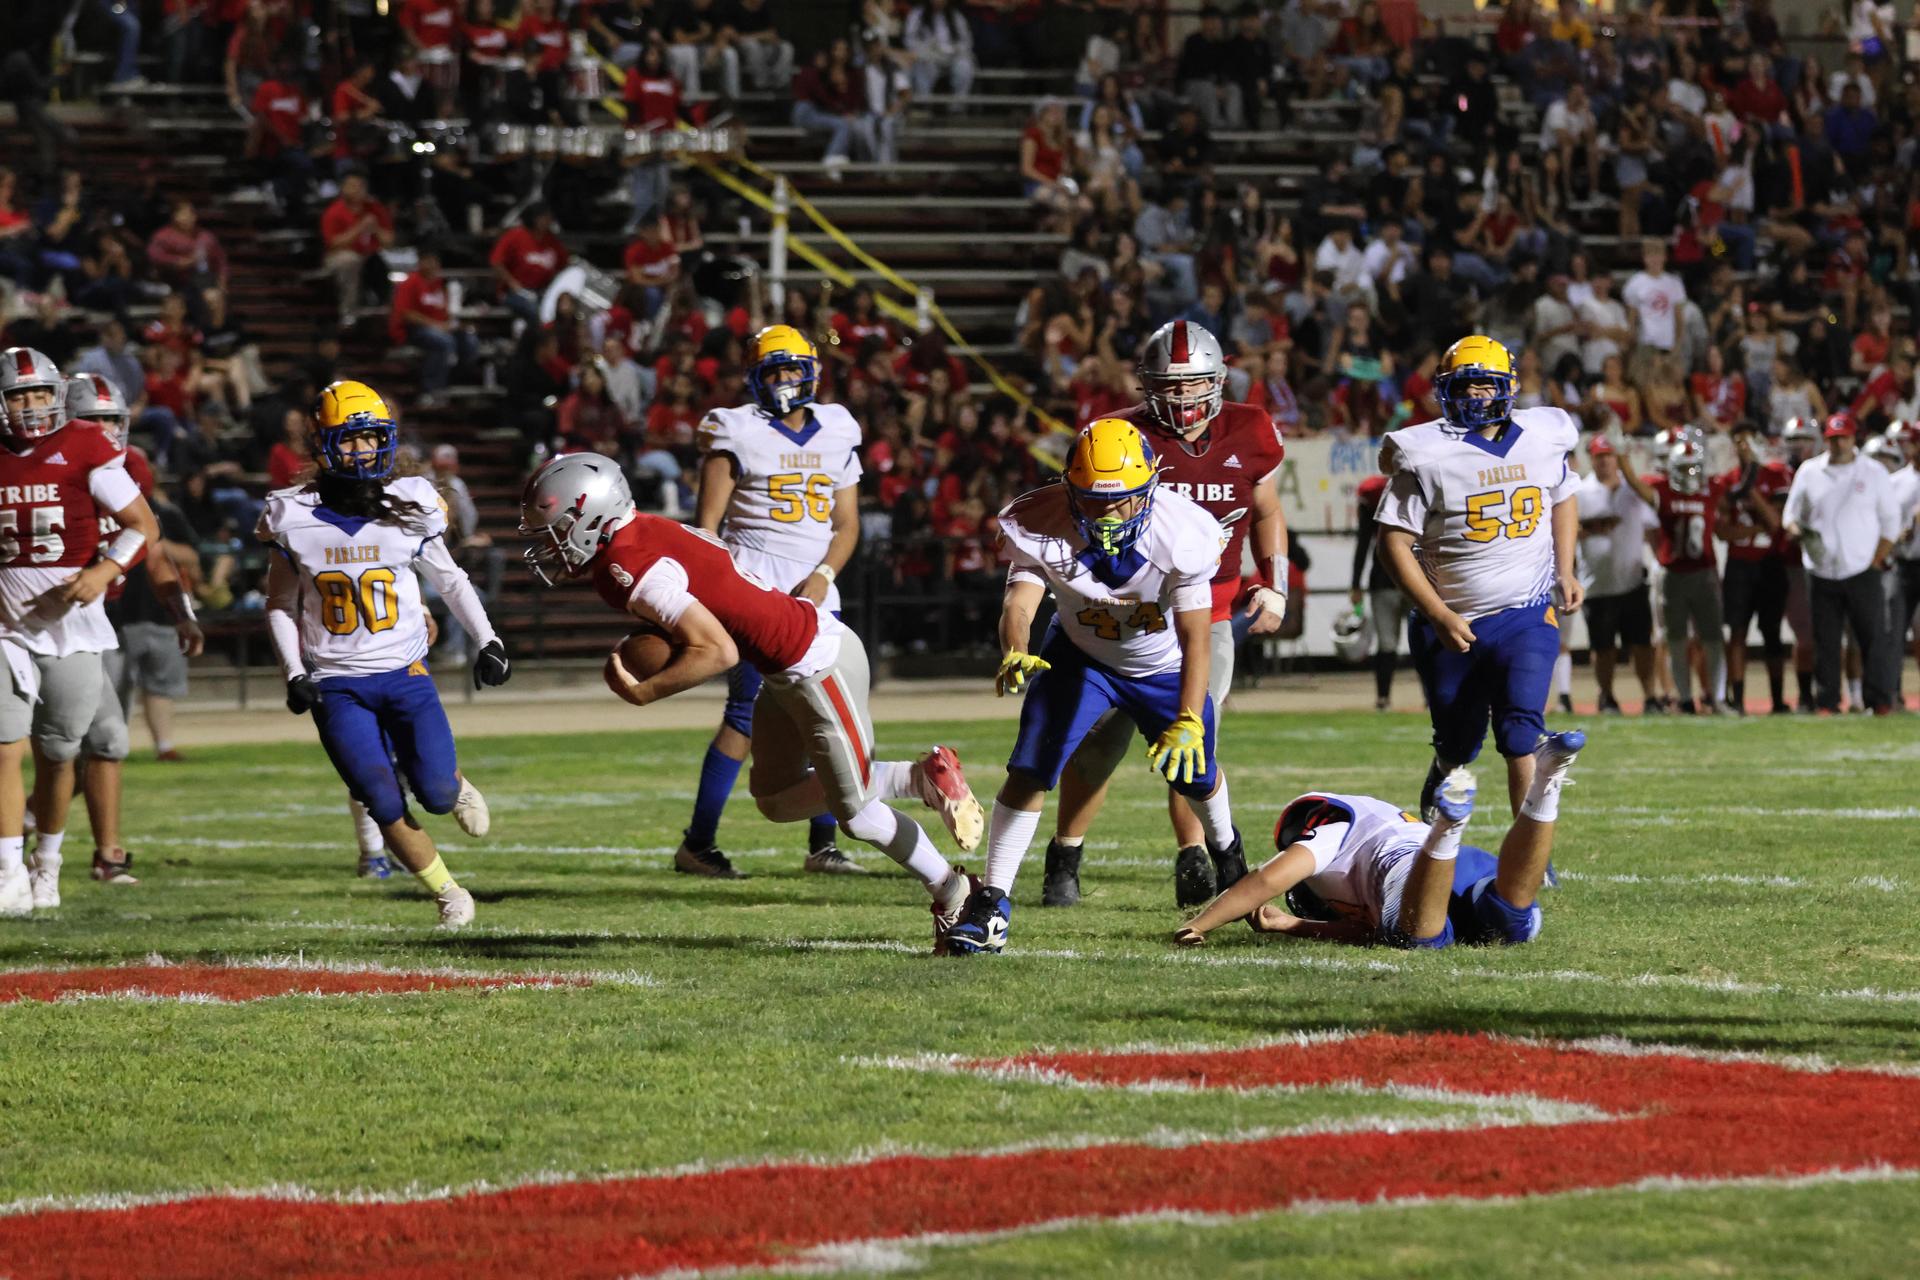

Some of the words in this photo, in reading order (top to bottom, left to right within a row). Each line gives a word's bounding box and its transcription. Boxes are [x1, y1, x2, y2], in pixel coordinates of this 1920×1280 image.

[767, 472, 834, 523] 56
[324, 544, 381, 564] PARLIER
[609, 562, 634, 588] 8
[313, 566, 400, 635] 80
[1076, 602, 1169, 640] 44
